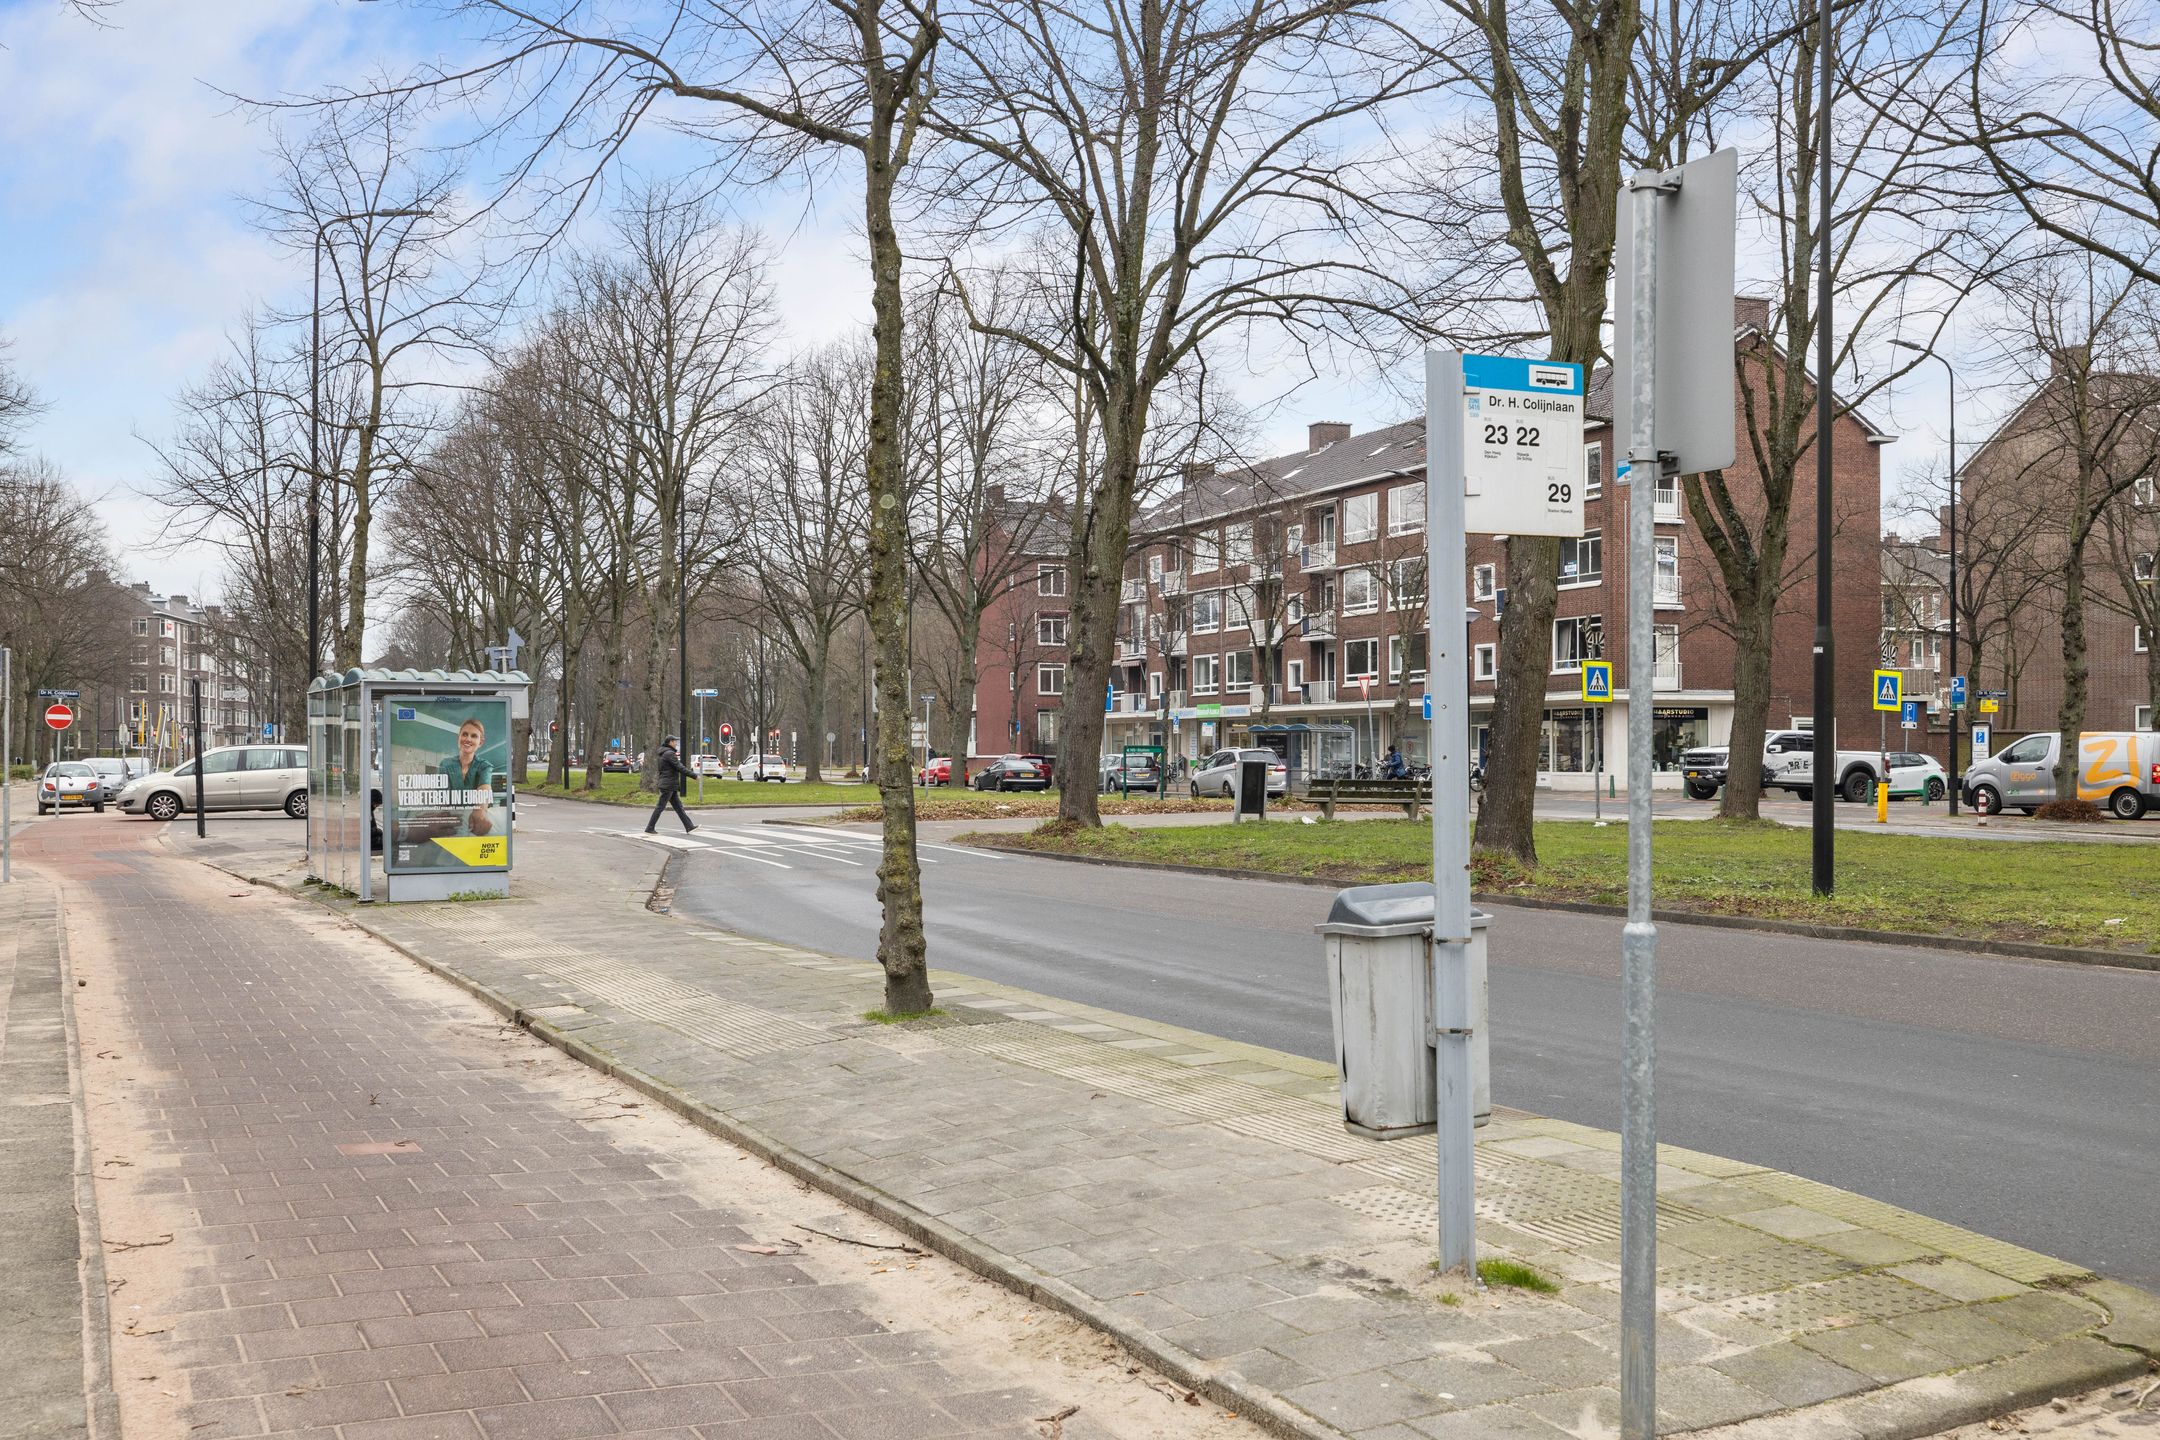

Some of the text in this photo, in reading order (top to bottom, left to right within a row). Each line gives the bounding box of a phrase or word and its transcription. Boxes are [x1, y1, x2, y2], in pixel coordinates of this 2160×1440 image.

[1489, 395, 1574, 413] Dr. H. Colijnlaan
[1484, 424, 1508, 445] 23
[1516, 426, 1540, 447] 22
[1548, 483, 1572, 504] 29
[398, 773, 449, 789] GEZONDHEID
[398, 789, 494, 805] VERBETEREN IN EUROPA
